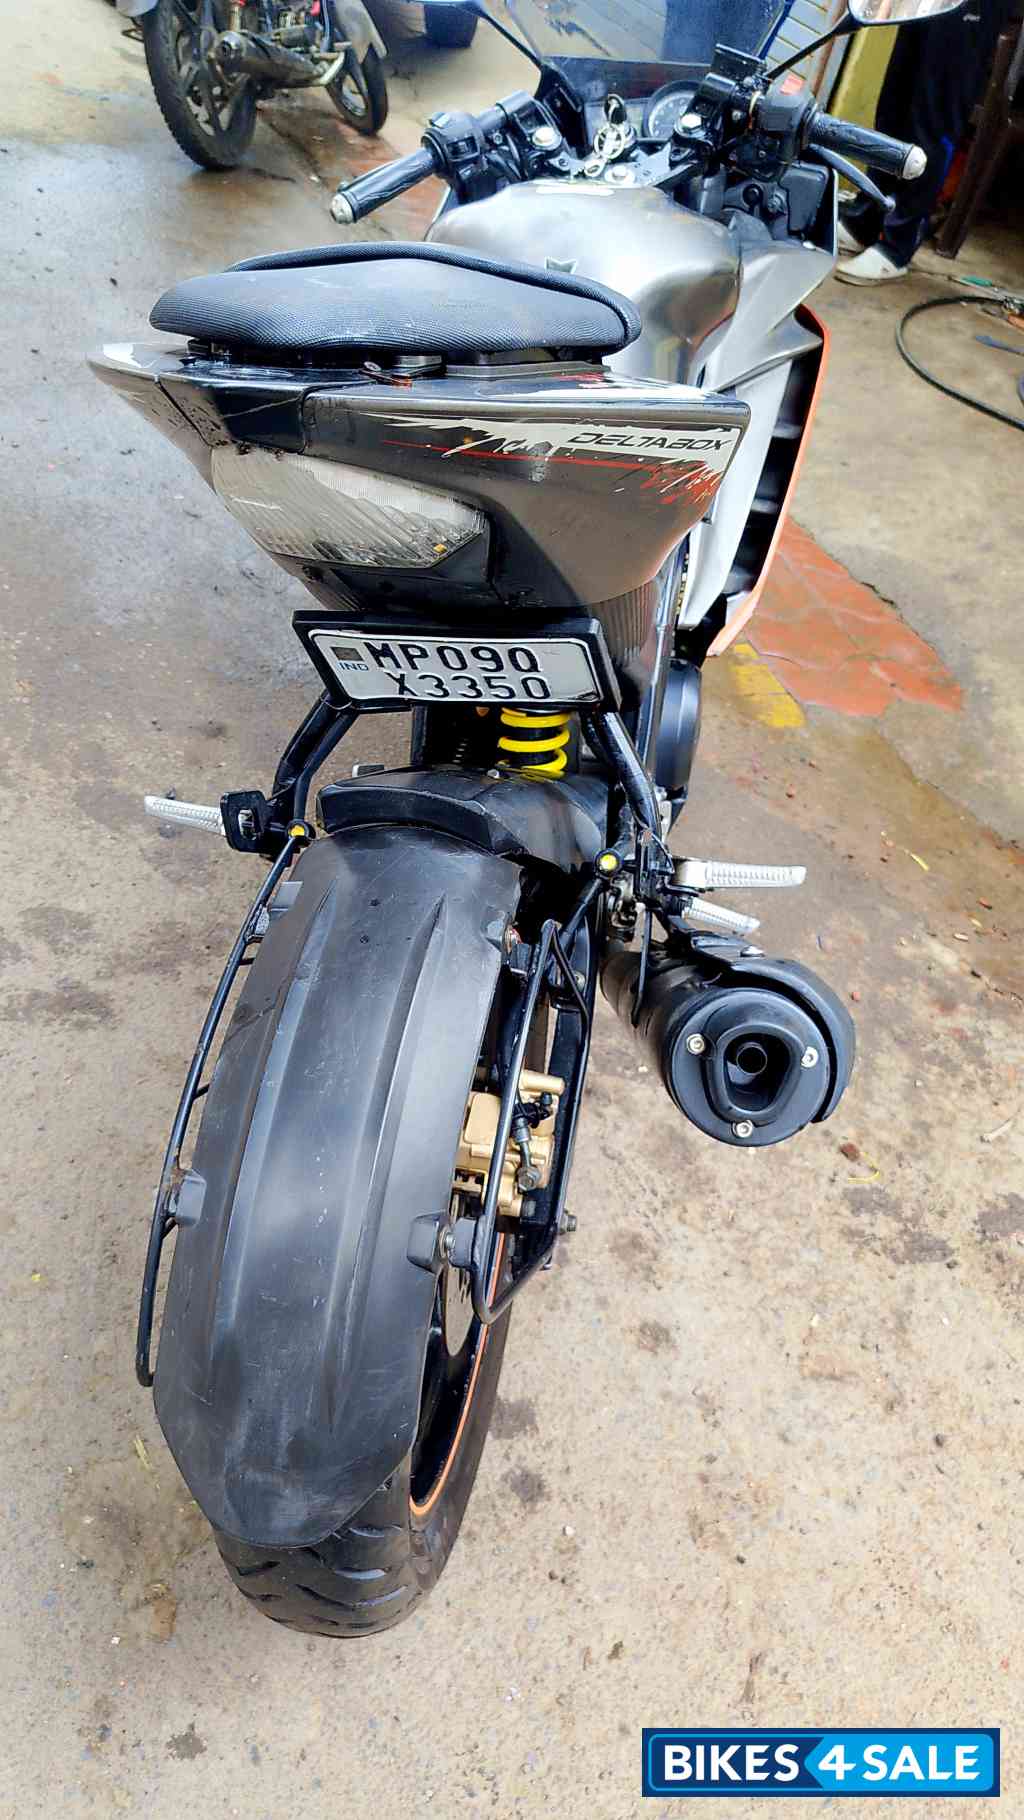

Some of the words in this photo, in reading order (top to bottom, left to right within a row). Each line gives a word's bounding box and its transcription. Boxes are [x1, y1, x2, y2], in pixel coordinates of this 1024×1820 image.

[568, 432, 731, 451] DELTABOX
[338, 662, 369, 671] IND
[384, 671, 551, 700] X3350
